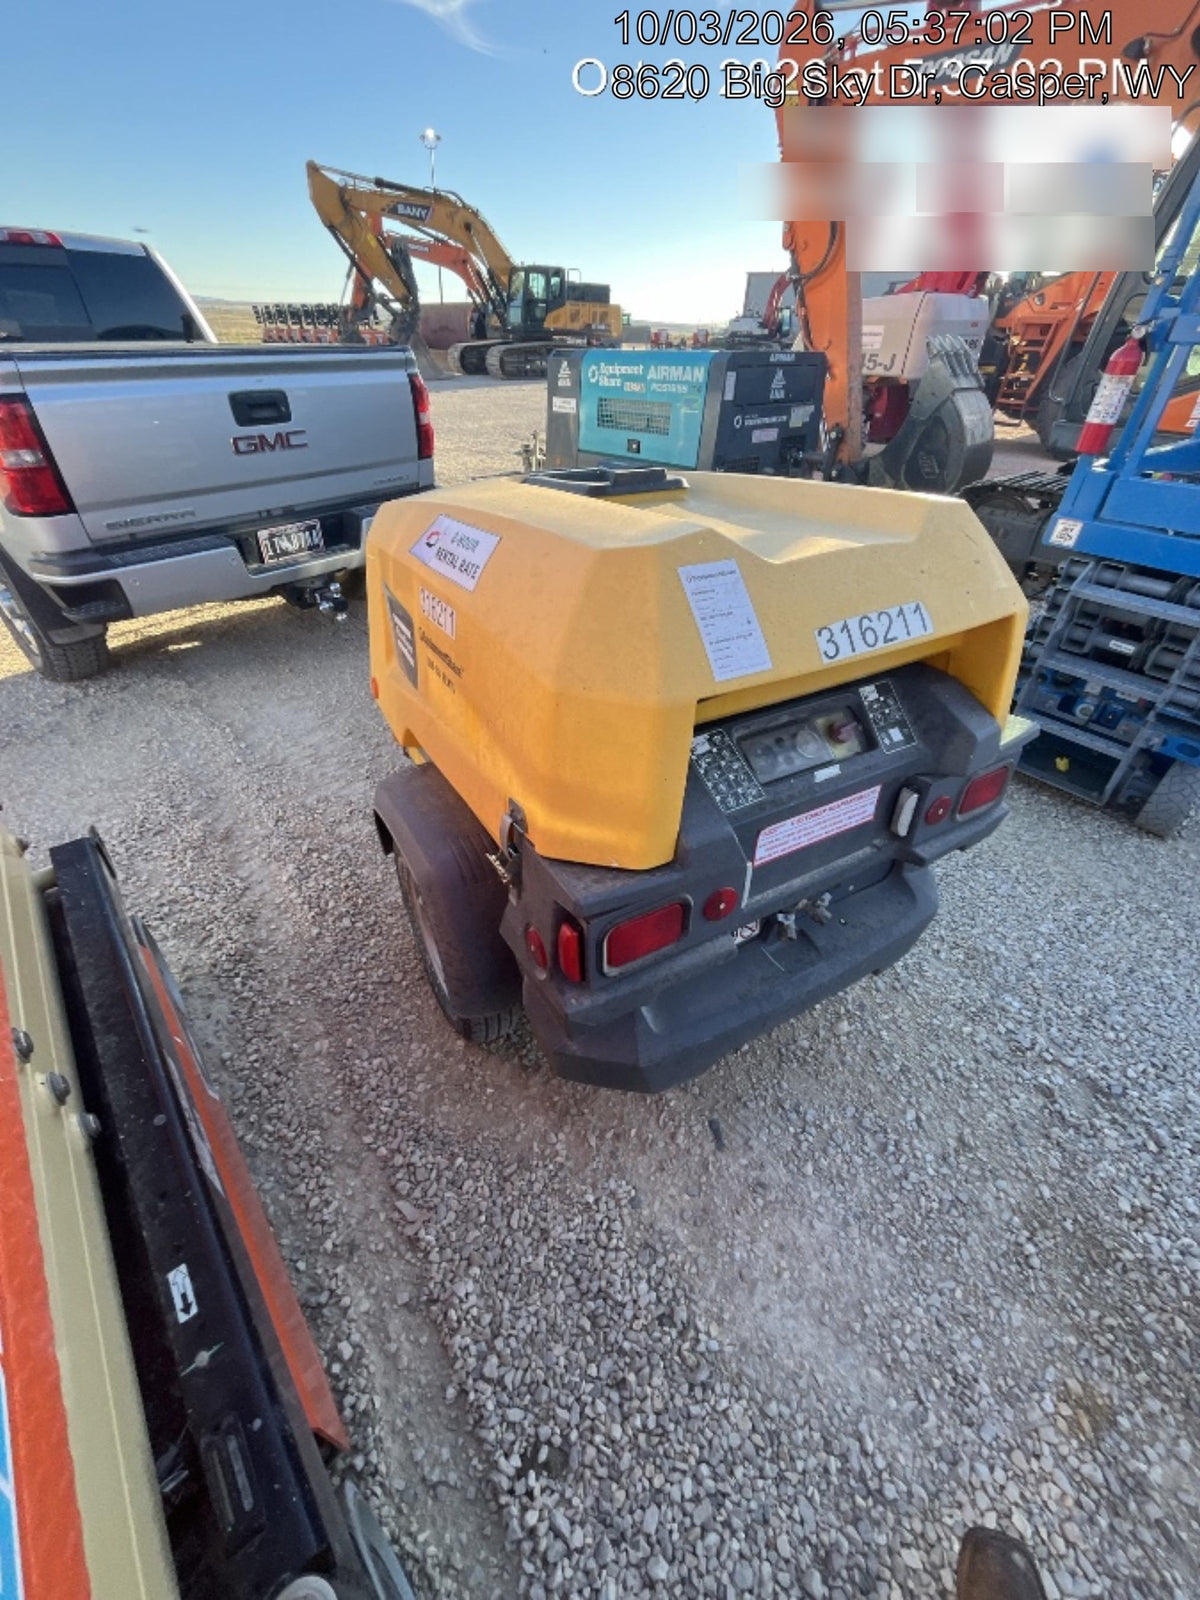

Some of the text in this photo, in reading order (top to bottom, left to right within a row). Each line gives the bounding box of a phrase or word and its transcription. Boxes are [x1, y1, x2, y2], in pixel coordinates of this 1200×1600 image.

[646, 365, 705, 382] AIRMAN
[231, 430, 308, 455] GMC
[817, 601, 929, 661] 316211
